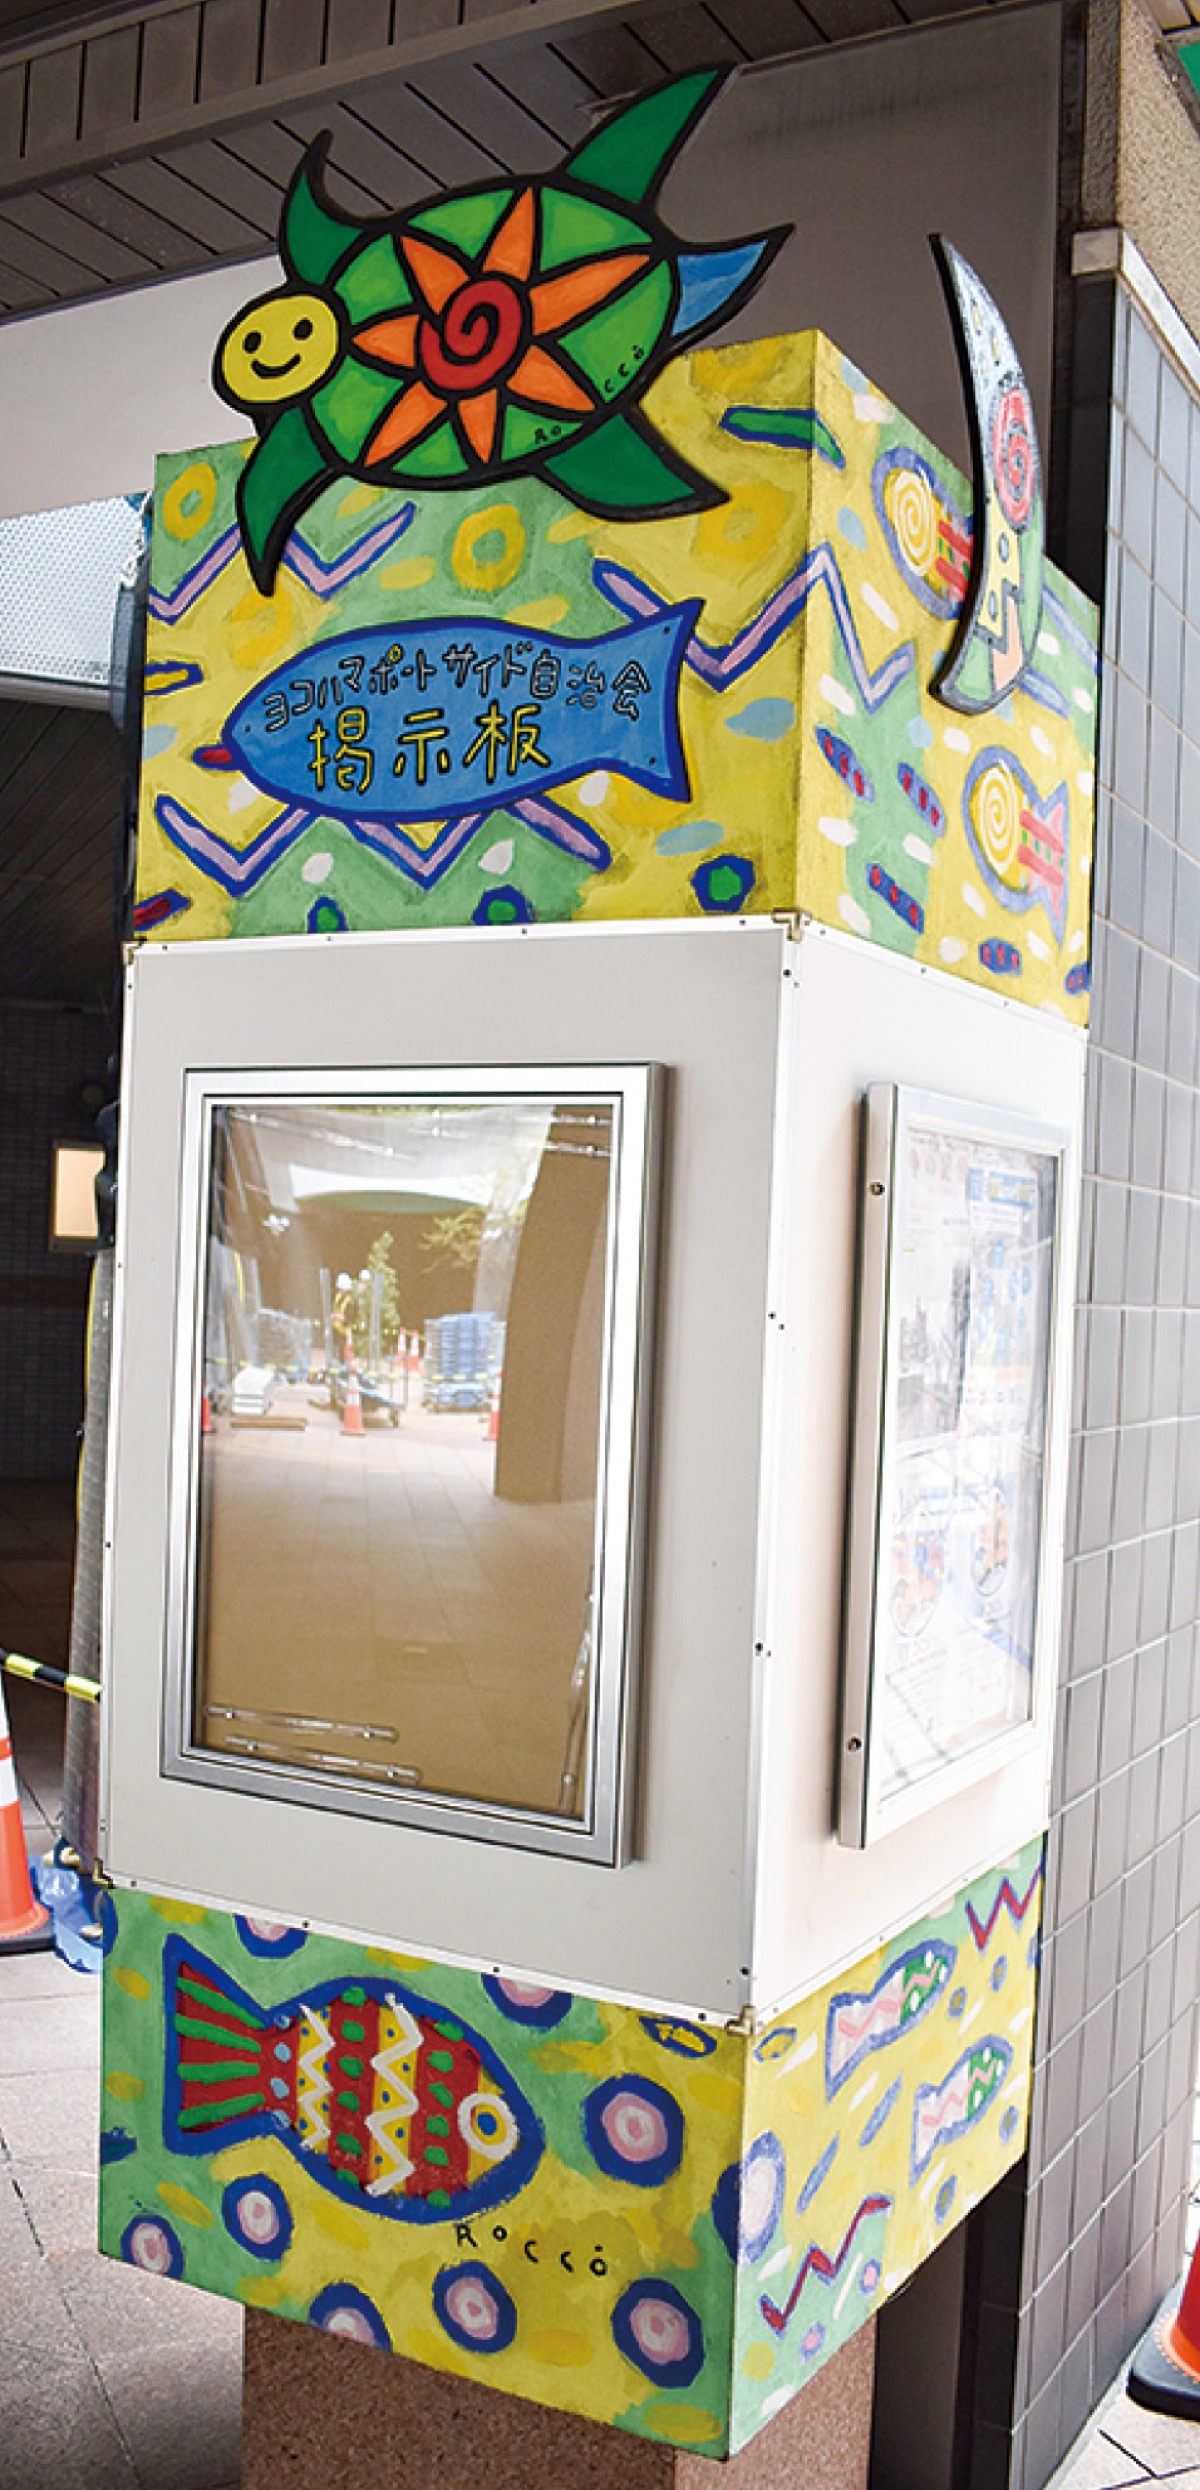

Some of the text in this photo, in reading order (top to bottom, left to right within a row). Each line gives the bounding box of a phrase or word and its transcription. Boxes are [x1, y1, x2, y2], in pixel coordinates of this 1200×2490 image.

[263, 641, 651, 733] ヨコハマポートサイド自治会
[307, 700, 551, 794] 掲示板
